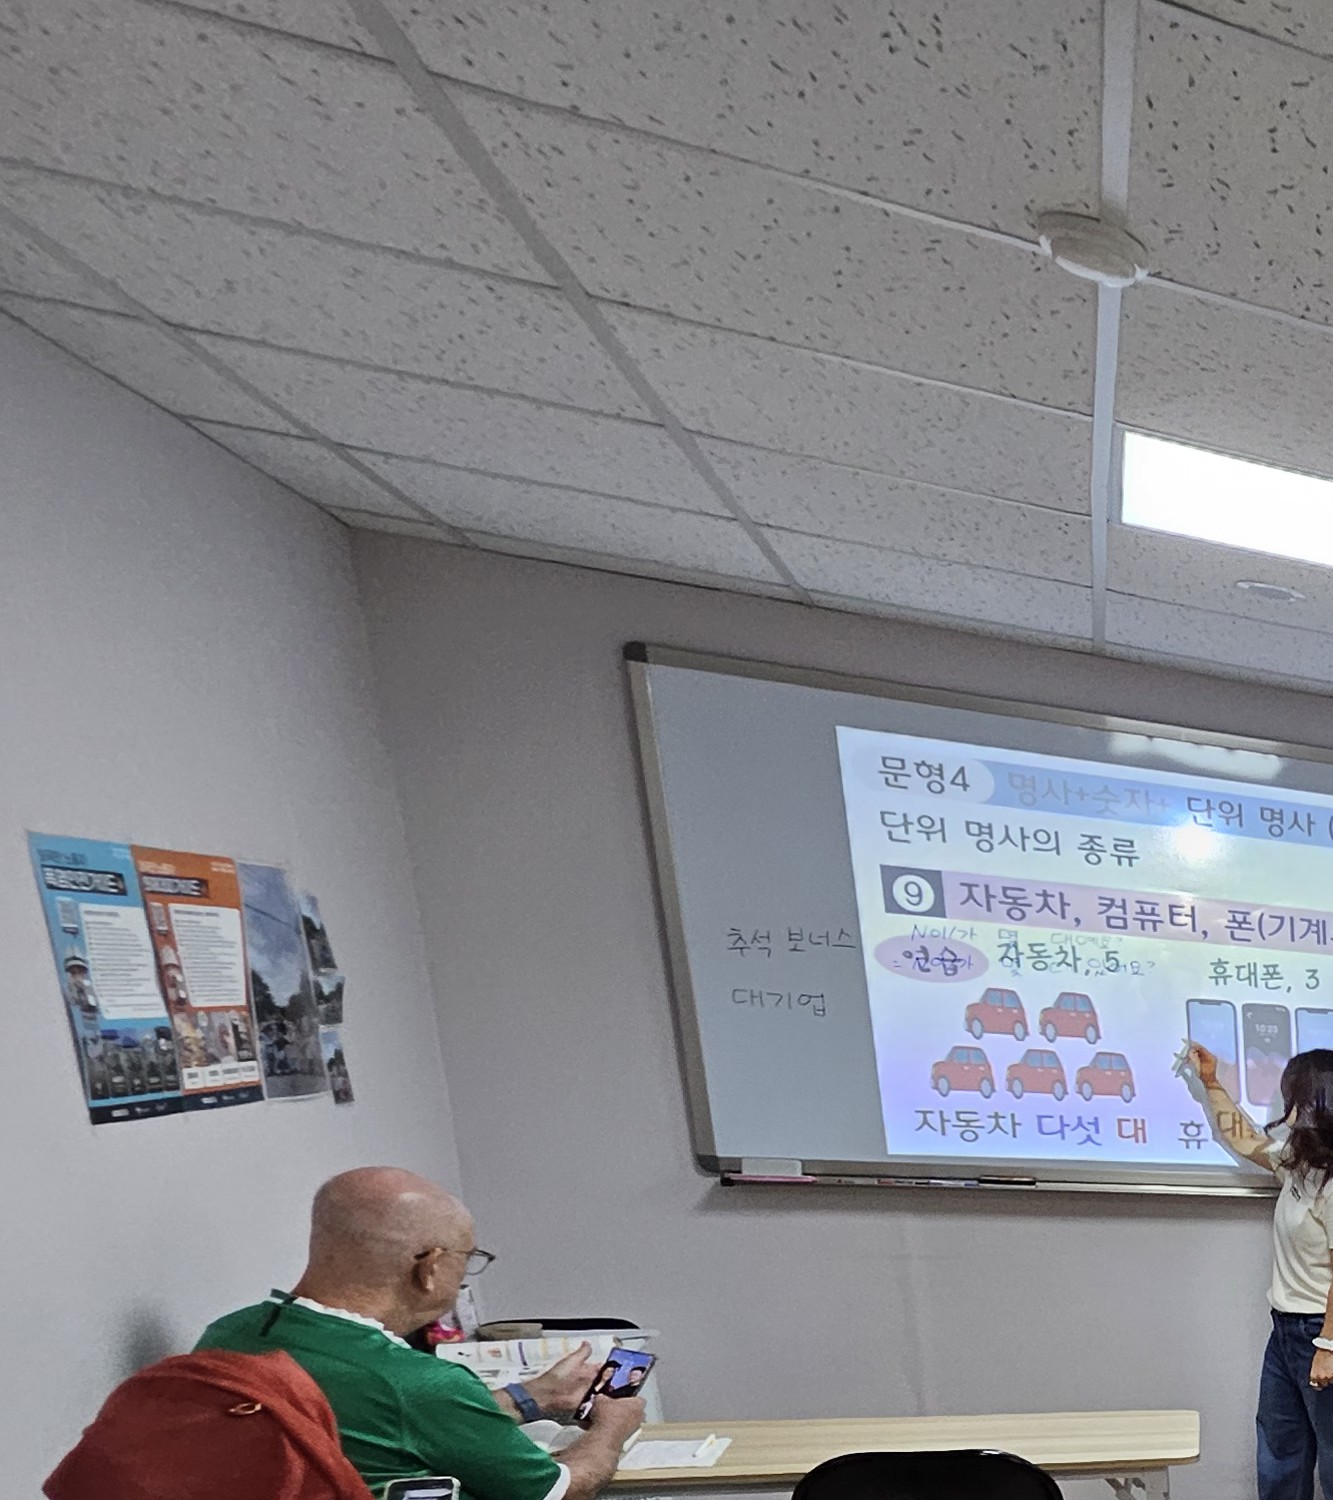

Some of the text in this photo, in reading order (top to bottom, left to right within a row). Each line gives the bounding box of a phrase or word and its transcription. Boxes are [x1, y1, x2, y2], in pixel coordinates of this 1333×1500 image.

[877, 755, 971, 795] 문형4
[1186, 795, 1244, 828] 단위
[1259, 805, 1316, 838] 명사
[879, 809, 1141, 869] 단위 명사의 종류
[958, 881, 1082, 928] 자동차,
[1096, 894, 1209, 942] 컴퓨터,
[727, 926, 857, 958] 추석 보너스
[997, 940, 1091, 977] 자동차,
[1207, 957, 1321, 994] 휴대폰, 3
[731, 988, 826, 1018] 대기업
[914, 1108, 1022, 1143] 자동차
[1036, 1113, 1103, 1147] 다섯
[1116, 1116, 1149, 1145] 대
